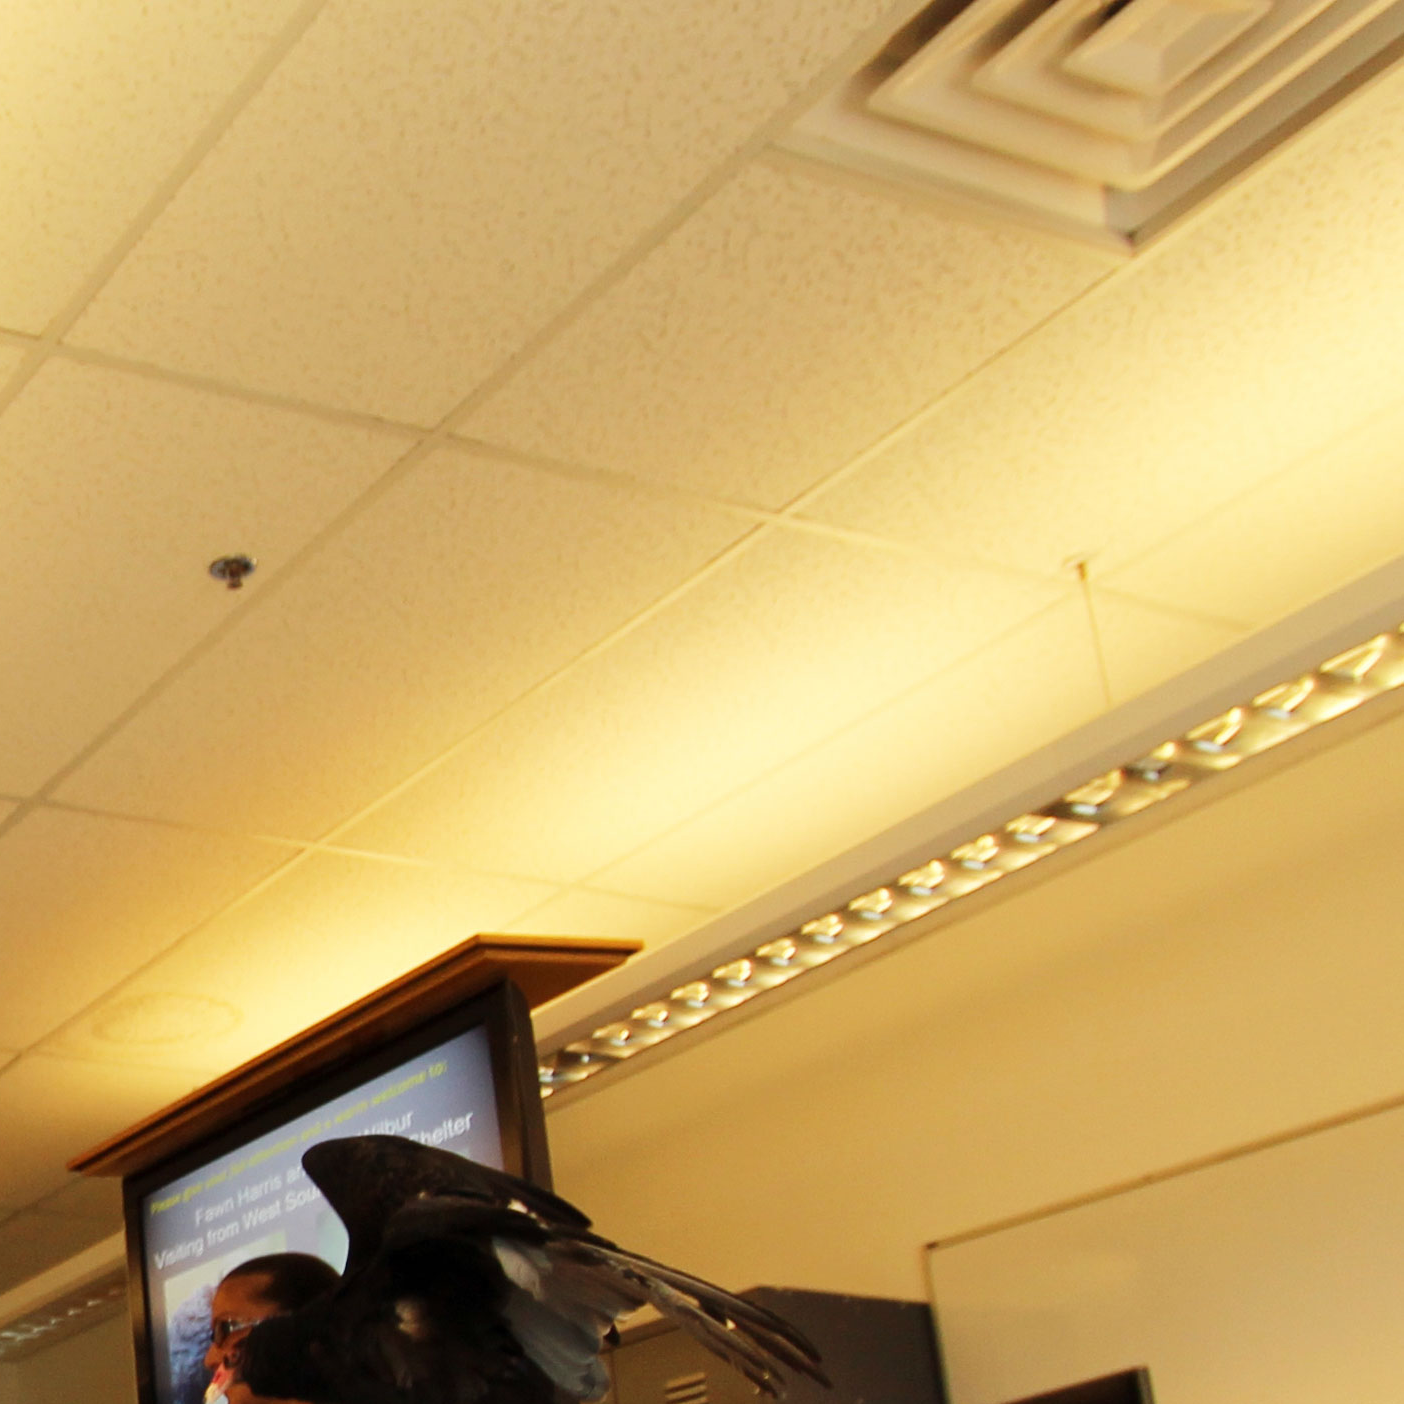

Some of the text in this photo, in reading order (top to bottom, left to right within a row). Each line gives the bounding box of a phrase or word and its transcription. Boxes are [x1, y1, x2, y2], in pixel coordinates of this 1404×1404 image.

[194, 1198, 235, 1227] Fawn
[236, 1175, 282, 1208] Harris
[154, 1237, 205, 1270] Visiting
[206, 1220, 240, 1247] from
[241, 1199, 282, 1232] West
